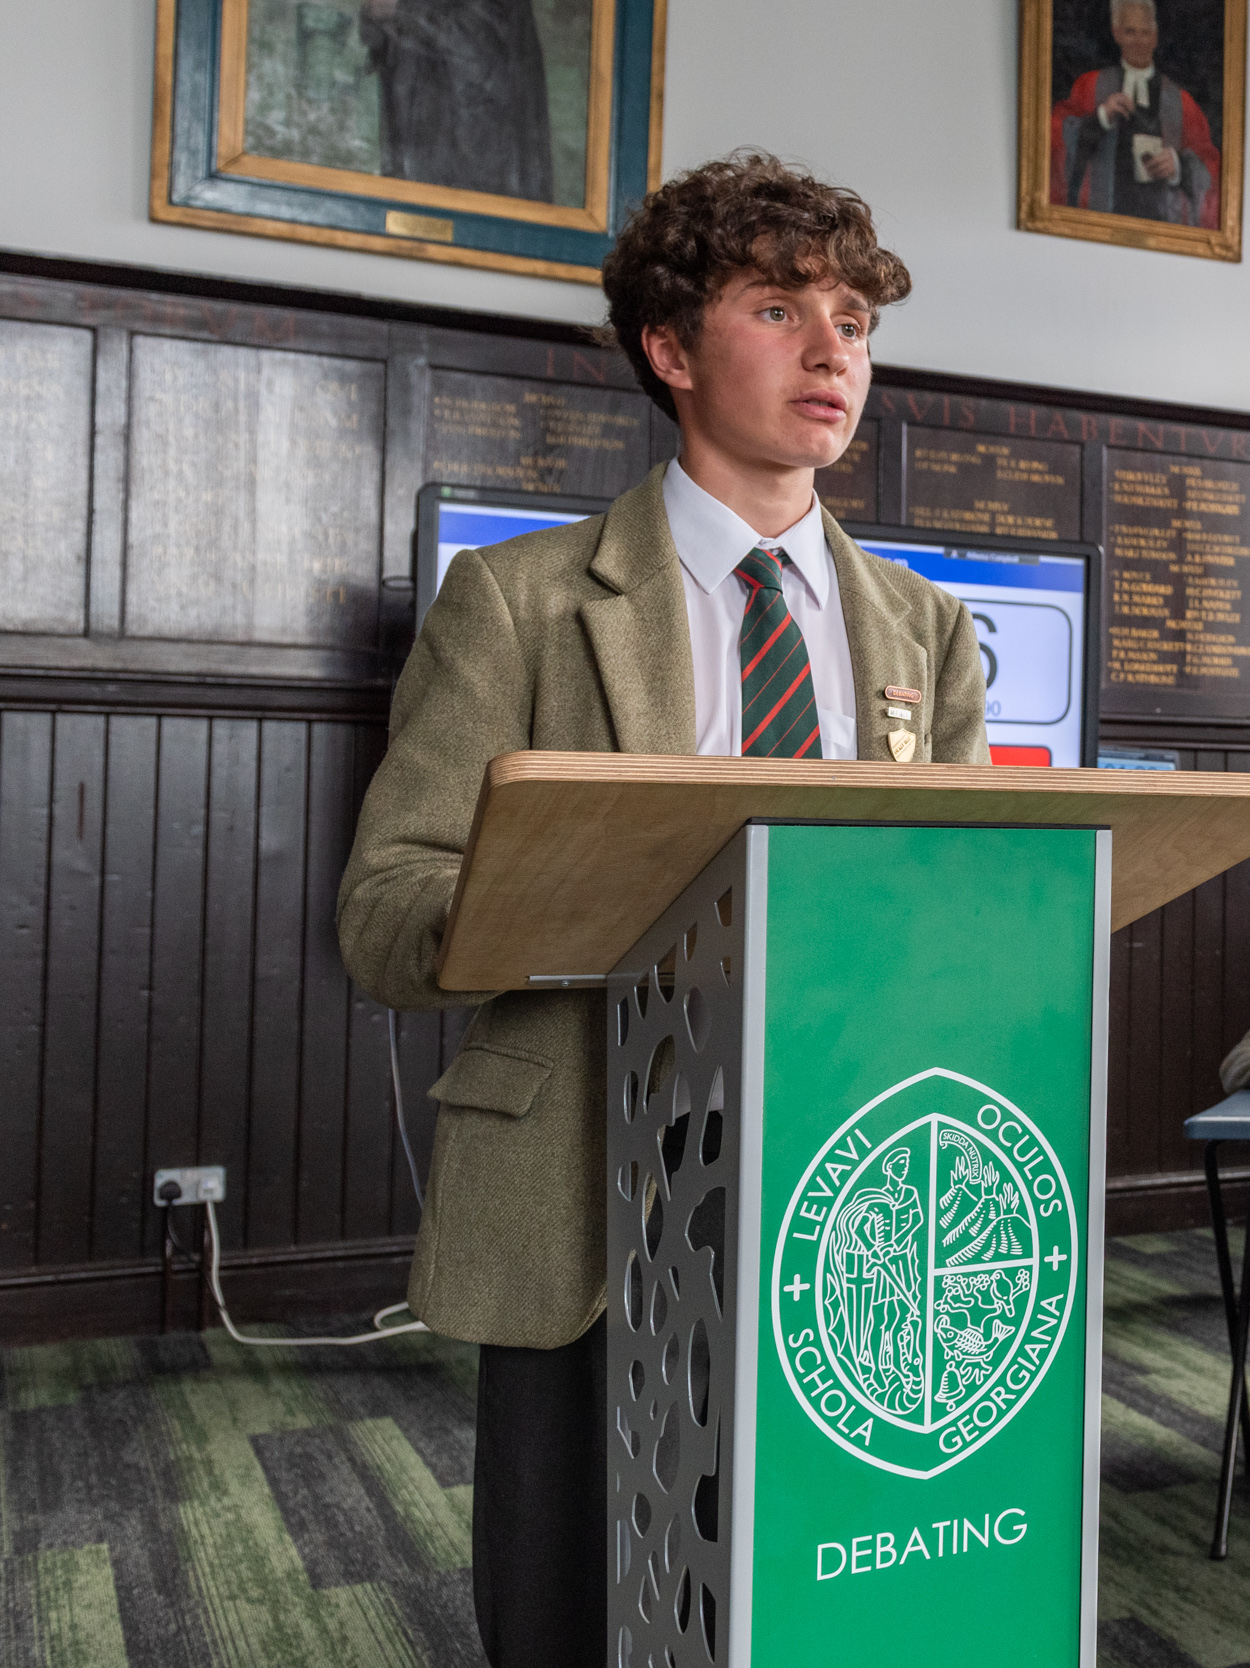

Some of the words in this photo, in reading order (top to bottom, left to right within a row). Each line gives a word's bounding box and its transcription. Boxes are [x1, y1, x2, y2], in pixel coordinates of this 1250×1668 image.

[1008, 405, 1250, 459] HABENTVR
[793, 1128, 873, 1241] LEVAVI
[977, 1104, 1062, 1218] OCULOS
[942, 1132, 969, 1149] SKIDDA
[966, 1146, 979, 1178] NUTRIX
[788, 1326, 873, 1447] SCHOLA
[938, 1293, 1065, 1455] GEORGIANA
[816, 1508, 1029, 1581] DEBATING
